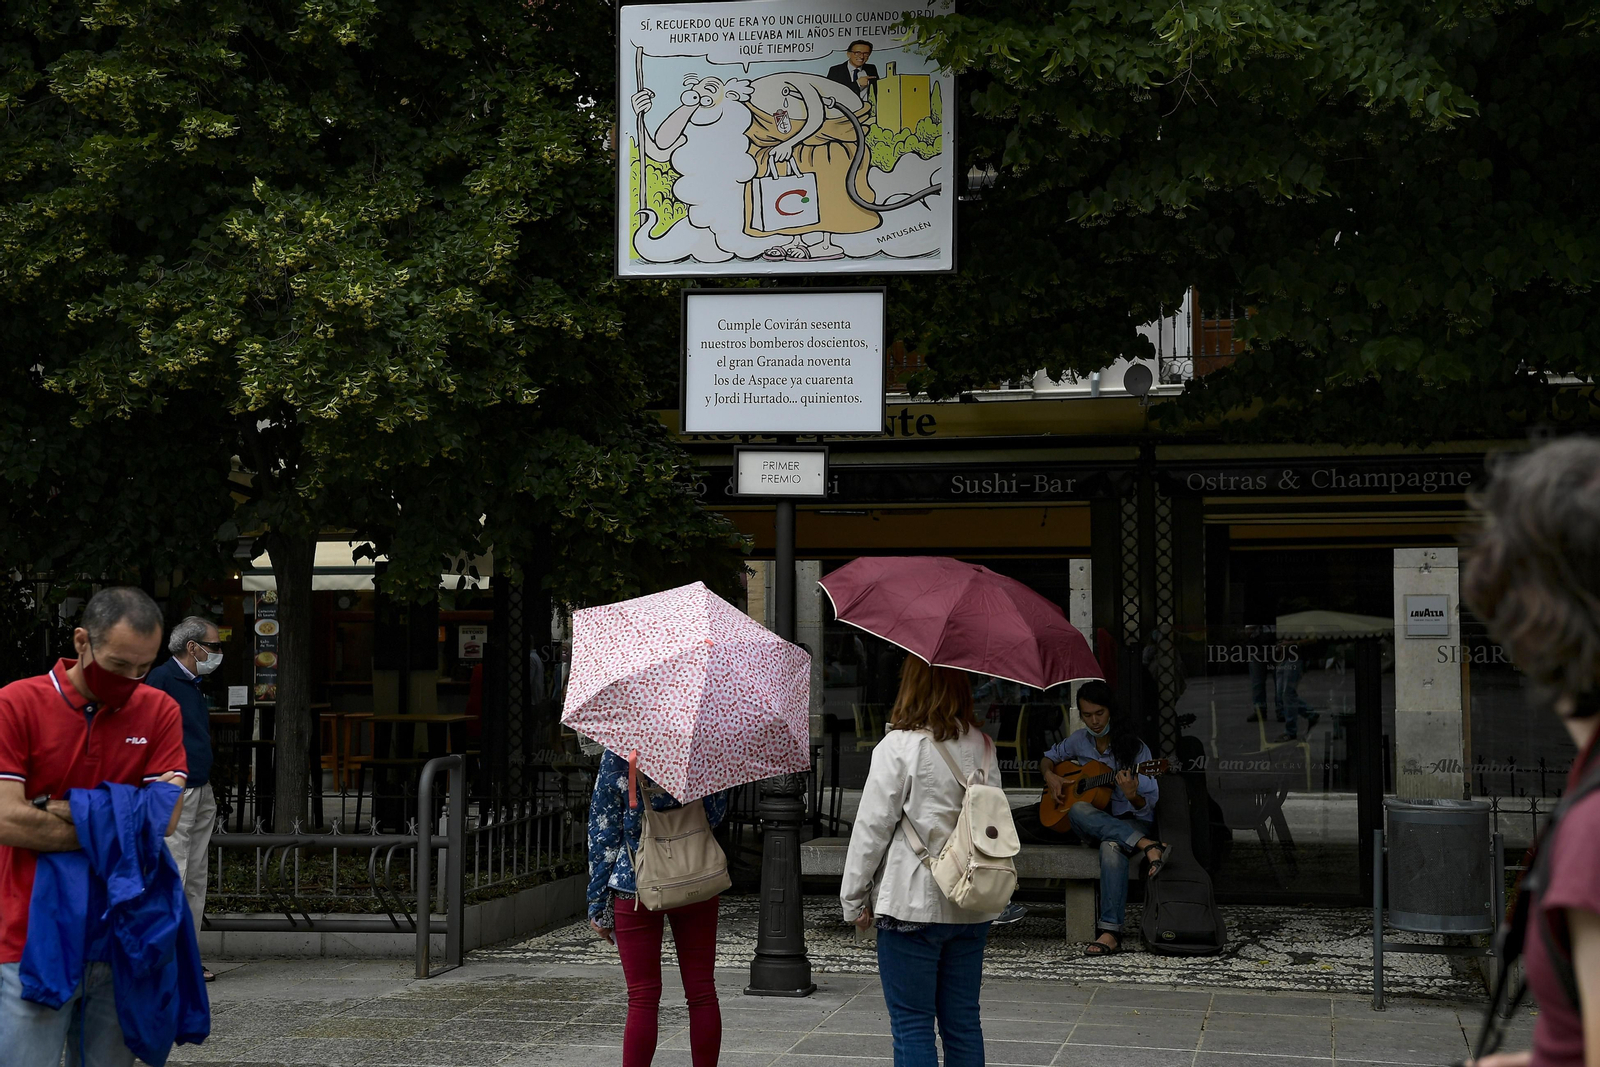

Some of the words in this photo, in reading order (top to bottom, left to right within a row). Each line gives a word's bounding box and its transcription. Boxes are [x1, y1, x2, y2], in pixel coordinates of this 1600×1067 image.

[640, 18, 653, 32] SÍ,
[656, 18, 711, 31] RECUERDO
[714, 17, 735, 29] QUE
[739, 16, 759, 27] ERA
[762, 15, 776, 26] YO
[779, 15, 794, 26] UN
[796, 12, 853, 25] CHIQUILLO
[855, 10, 899, 22] CUANDO
[901, 9, 935, 20] ORDI
[669, 32, 719, 44] HURTADO
[722, 32, 735, 42] YA
[738, 30, 783, 41] LLEVABA
[786, 29, 804, 39] MIL
[807, 25, 835, 38] AÑOS
[838, 27, 852, 37] EN
[767, 42, 814, 54] TIEMPOS!
[876, 220, 932, 244] MATUSALÉN
[717, 319, 762, 334] Cumple
[764, 318, 808, 330] Covirán
[810, 319, 851, 330] sesenta
[700, 339, 747, 349] nuestros
[749, 337, 804, 349] bomberos
[806, 336, 869, 349] doscientos,
[716, 356, 727, 367] el
[729, 359, 754, 370] gran
[756, 355, 805, 367] Granada
[807, 357, 851, 367] noventa
[714, 374, 730, 386] los
[732, 374, 746, 386] de
[748, 374, 788, 389] Aspace
[790, 378, 803, 388] ya
[805, 375, 854, 385] cuarenta
[705, 396, 712, 408] y
[714, 392, 741, 406] Jordi
[743, 391, 798, 404] Hurtado...
[800, 392, 863, 407] quinientos.
[762, 461, 800, 471] PRIMER
[760, 474, 802, 485] PREMIO
[950, 473, 1077, 494] Sushi-Bar
[1186, 472, 1267, 491] Ostras
[1277, 469, 1301, 490] &
[1311, 468, 1472, 493] Champagne
[1410, 608, 1444, 617] LAVAZZA
[125, 736, 148, 744] FILA
[1187, 755, 1271, 771] Alamra
[1274, 762, 1331, 770] CERVZAS
[1429, 758, 1517, 774] Alhmbra
